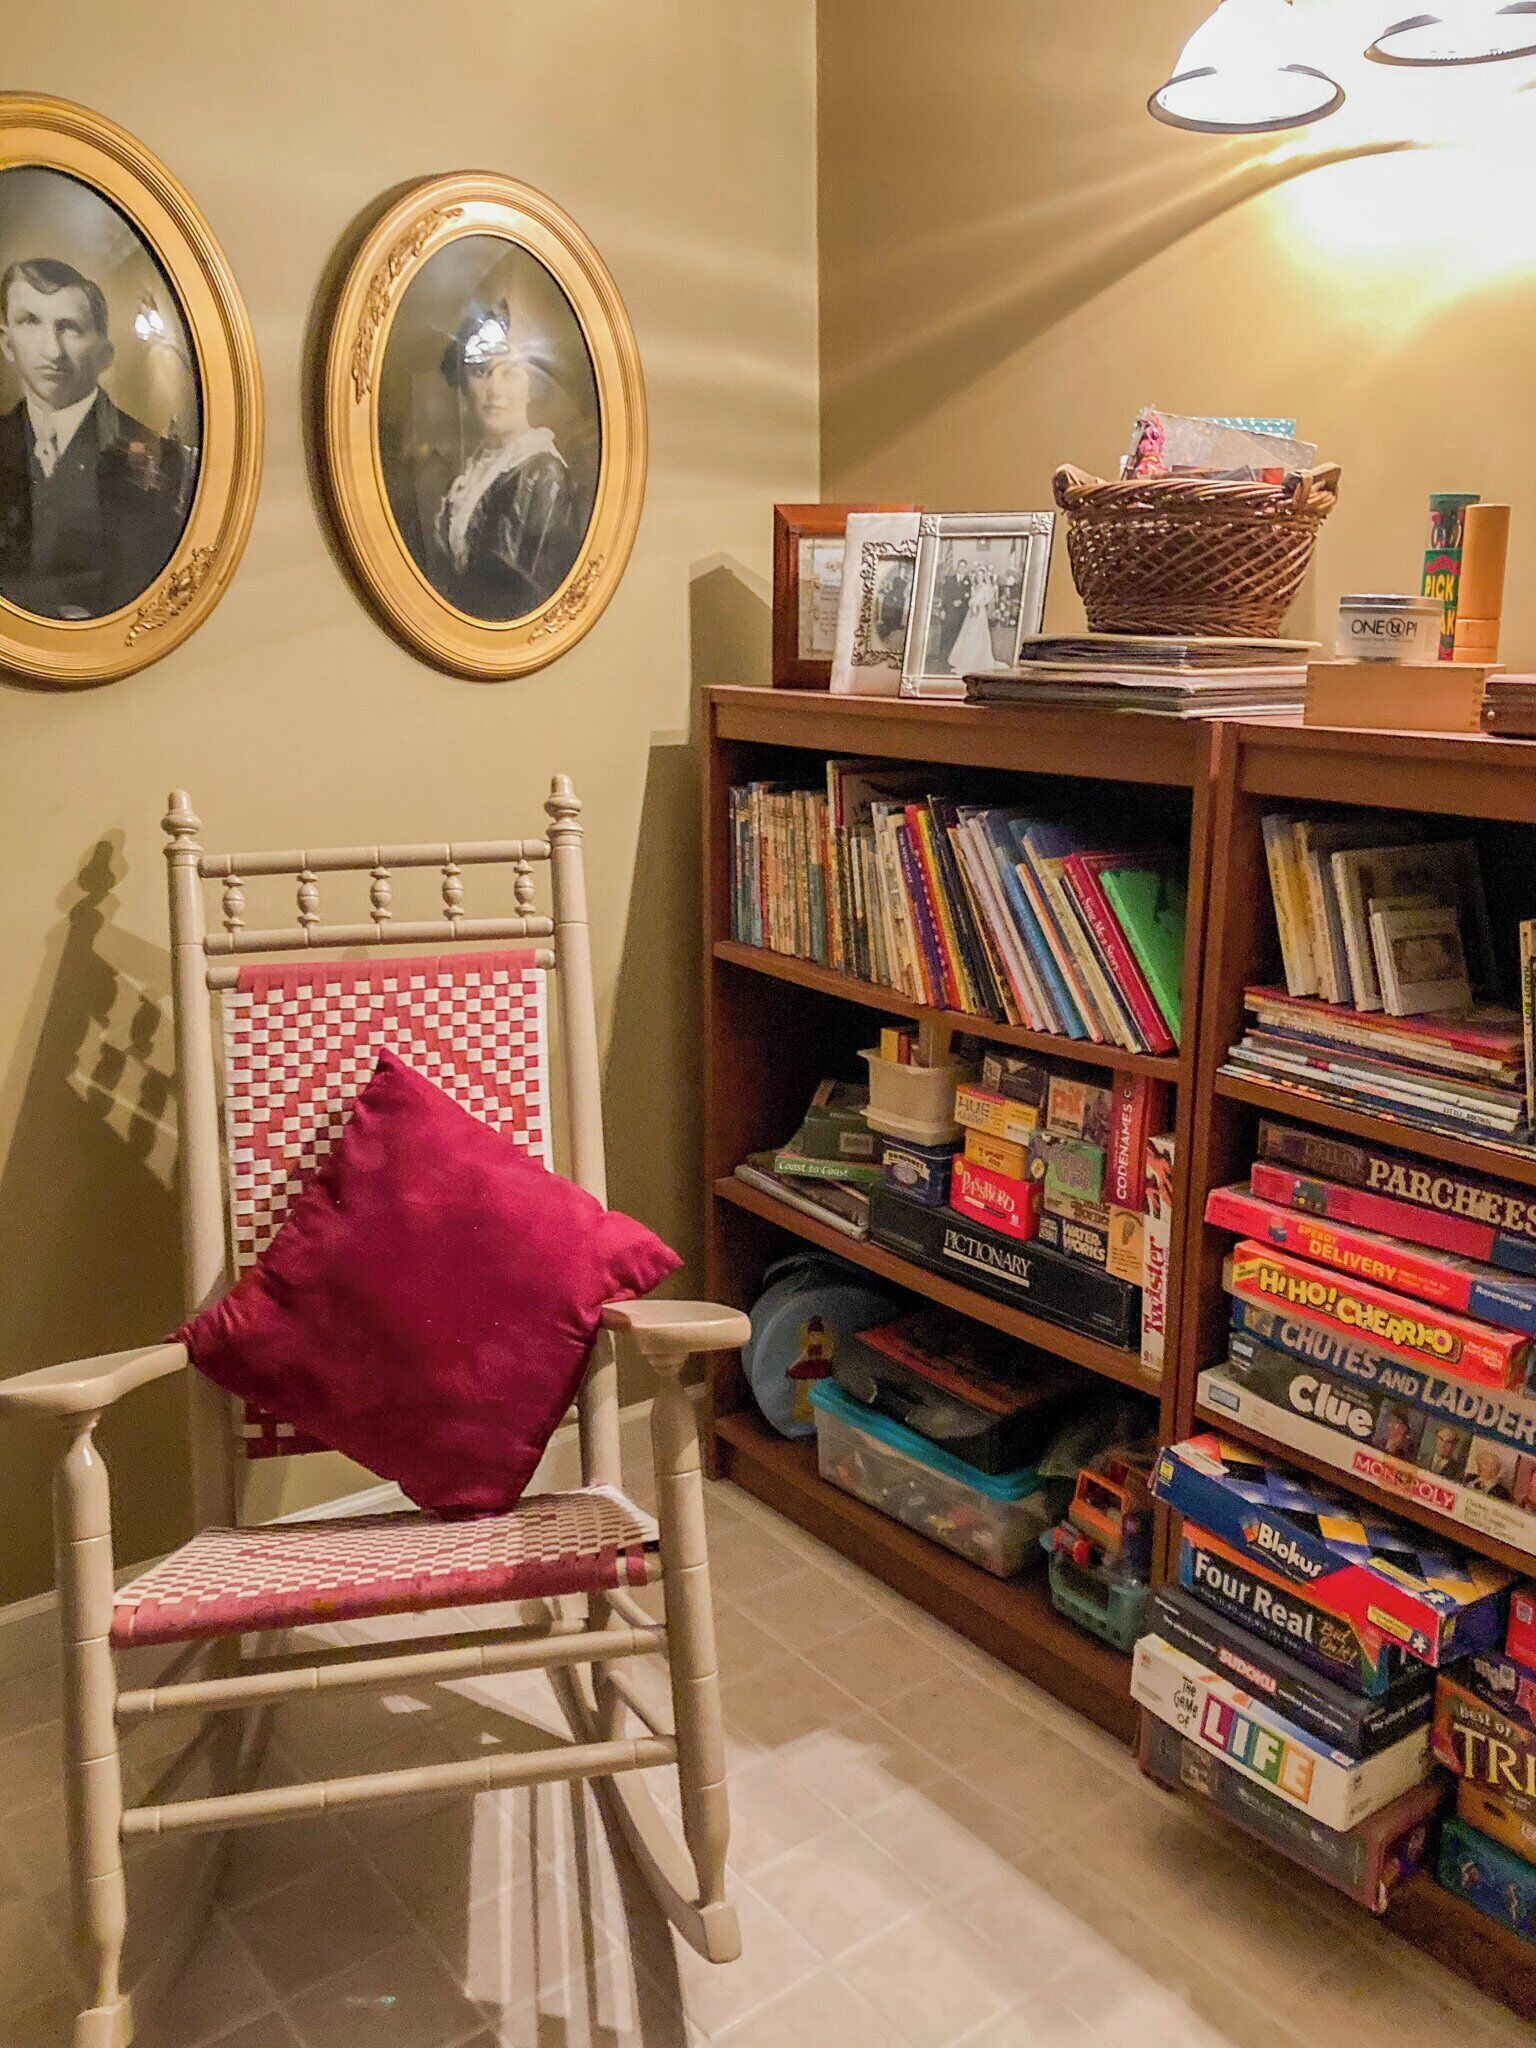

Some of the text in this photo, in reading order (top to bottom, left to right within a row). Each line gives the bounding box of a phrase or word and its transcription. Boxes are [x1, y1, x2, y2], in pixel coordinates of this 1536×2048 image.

[1117, 1103, 1133, 1200] CODENAMES
[943, 1229, 1032, 1278] PICTIONARY
[1143, 1235, 1165, 1336] Twister
[1308, 1238, 1399, 1282] DELIVERY
[1280, 1316, 1379, 1380] CHUTES
[1377, 1372, 1421, 1398] AND
[1289, 1374, 1374, 1437] Clue
[1257, 1521, 1324, 1578] Blokus
[1194, 1552, 1252, 1605] Four
[1252, 1584, 1315, 1645] Real
[1201, 1696, 1314, 1802] LIFE
